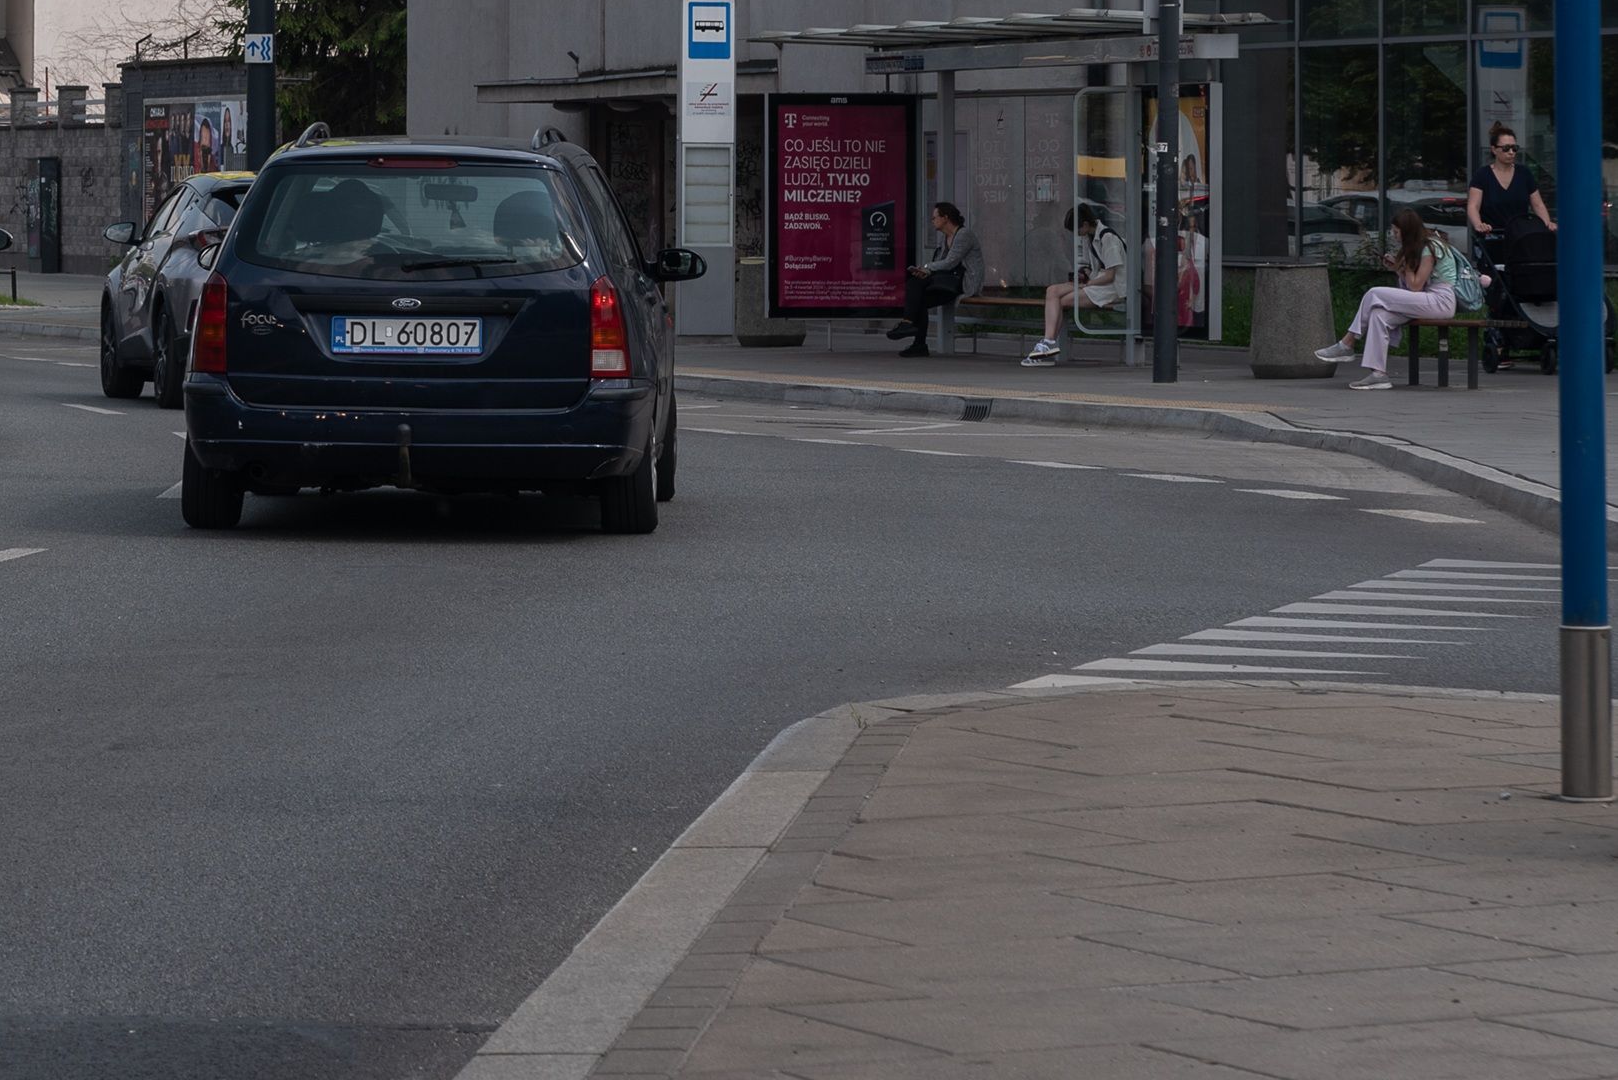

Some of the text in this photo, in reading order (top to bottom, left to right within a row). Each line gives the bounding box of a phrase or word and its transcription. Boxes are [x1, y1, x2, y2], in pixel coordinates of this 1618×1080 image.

[784, 136, 886, 153] CO JEŚLI TO NIE
[784, 156, 871, 172] ZASIĘG DZIELI
[784, 173, 870, 188] LUDZI, TYLKO
[784, 190, 862, 203] MILCZENIE?
[784, 211, 831, 222] BĄDŹ BLISKO.
[784, 221, 823, 230] ZADZWOŃ.
[350, 322, 478, 346] DL 60807
